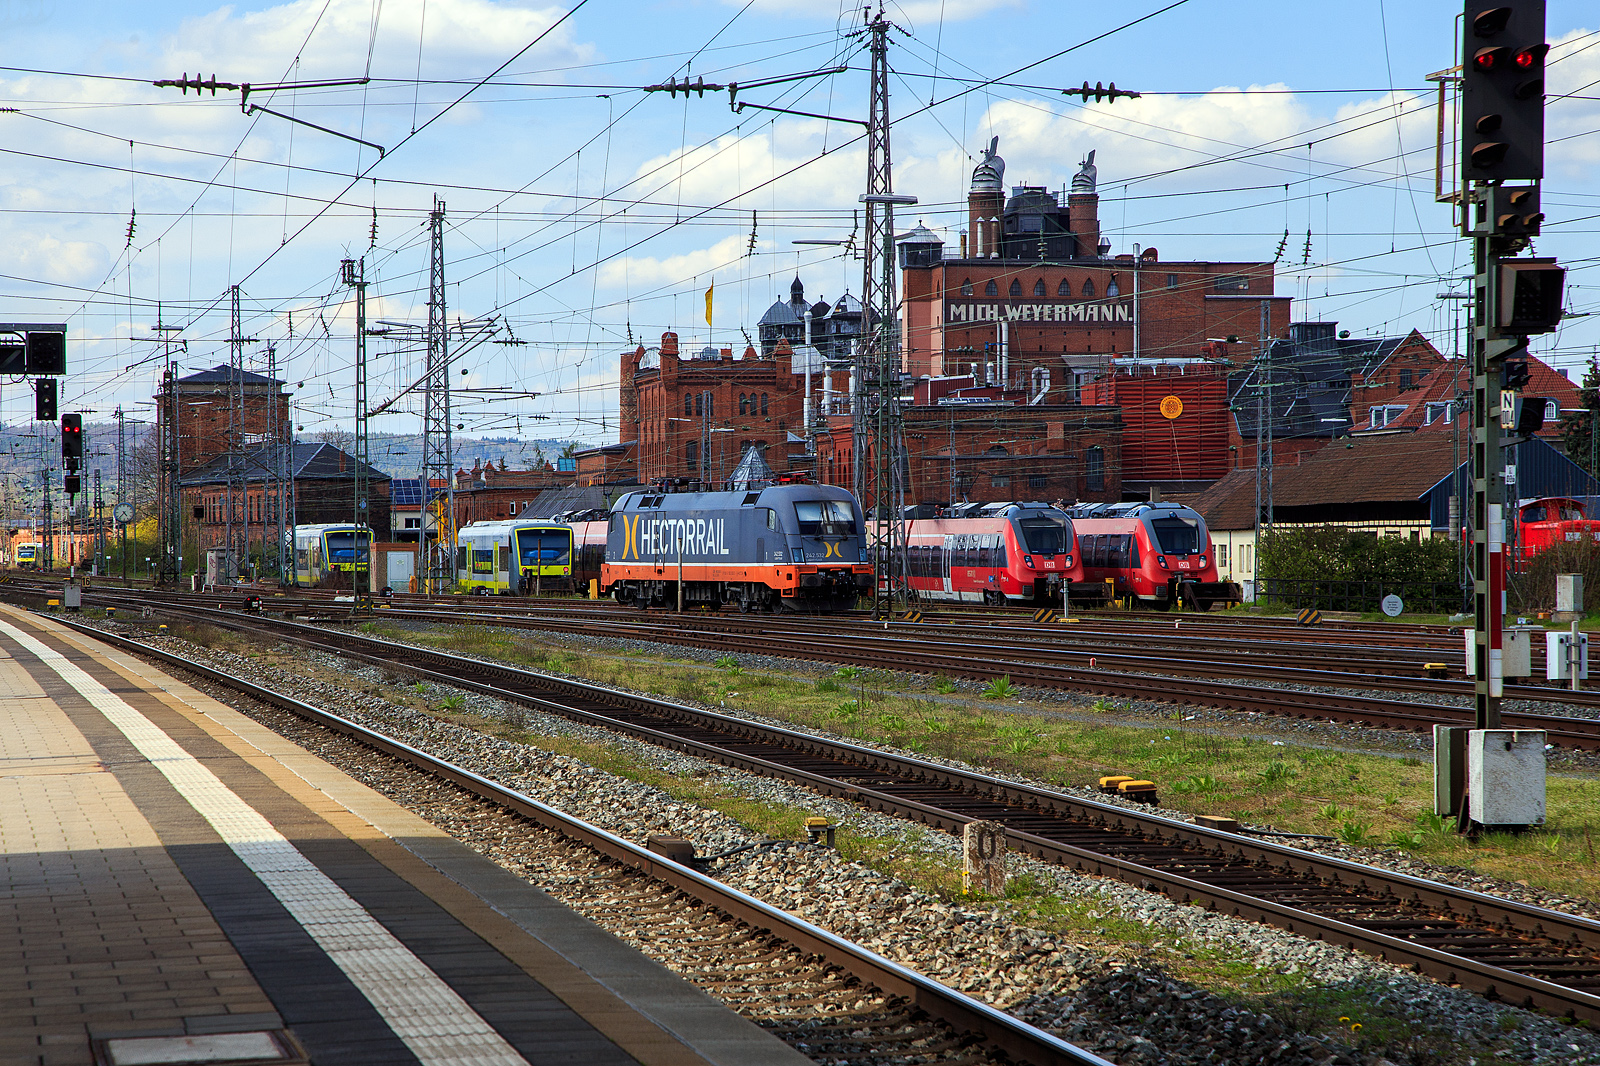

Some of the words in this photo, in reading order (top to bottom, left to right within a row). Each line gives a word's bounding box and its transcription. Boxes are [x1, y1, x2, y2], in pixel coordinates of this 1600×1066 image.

[950, 304, 1003, 322] MICH.
[1503, 393, 1512, 408] N
[641, 518, 730, 555] HECTORRAIL
[1044, 561, 1055, 569] DB
[1178, 561, 1190, 569] DB
[82, 577, 90, 586] 16
